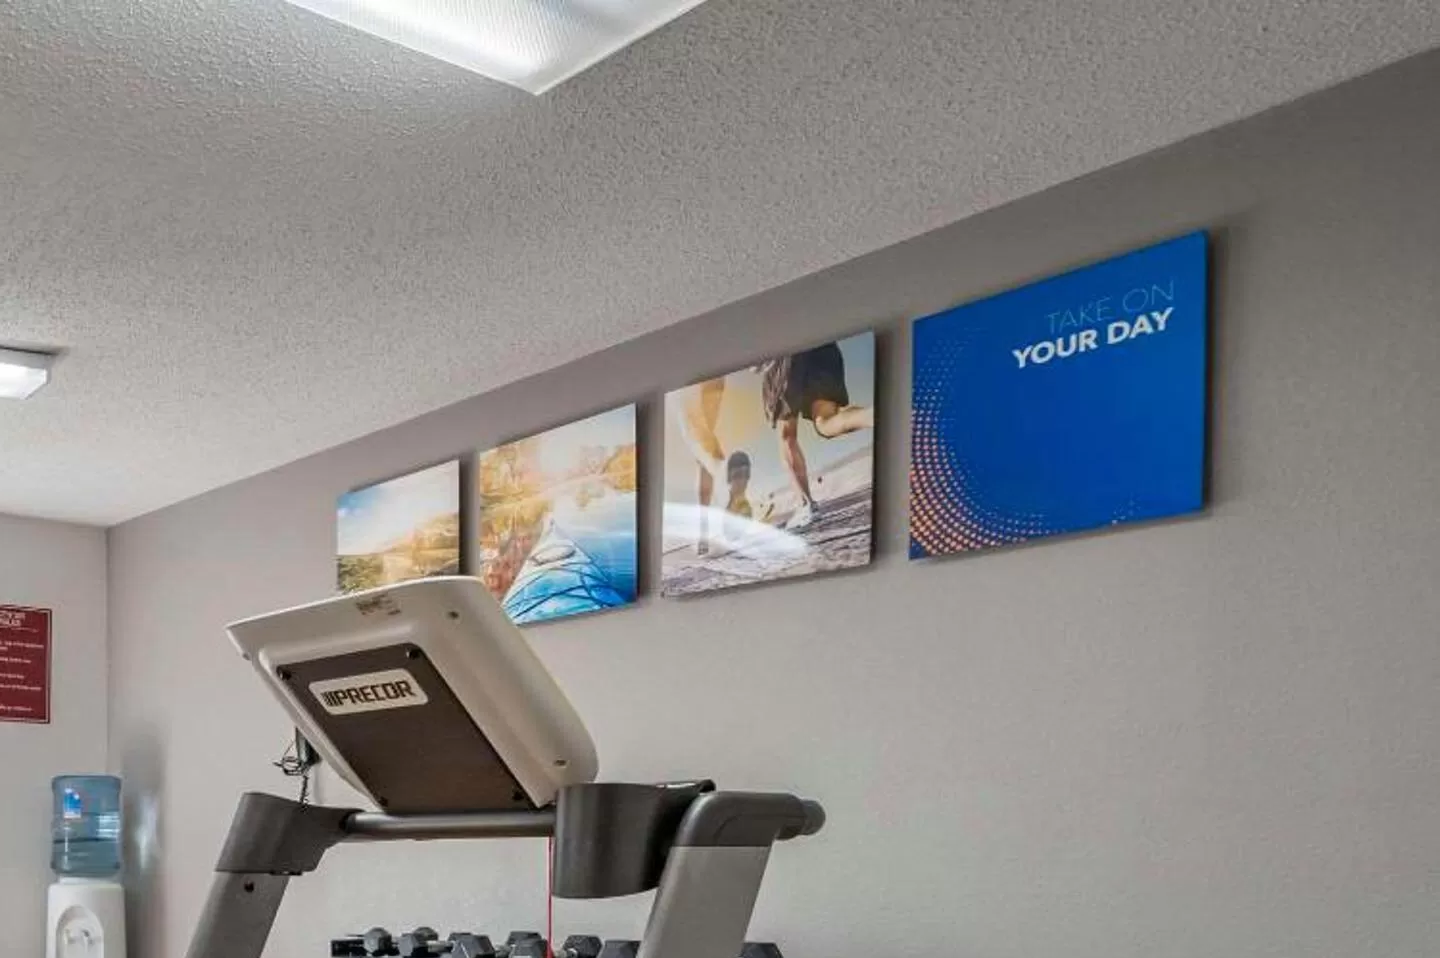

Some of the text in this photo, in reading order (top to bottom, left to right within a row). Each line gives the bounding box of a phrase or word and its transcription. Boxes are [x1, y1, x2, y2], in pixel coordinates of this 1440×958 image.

[1047, 280, 1175, 334] TAKE ON
[1012, 307, 1175, 369] YOUR DAY
[323, 680, 417, 706] PRECOR
